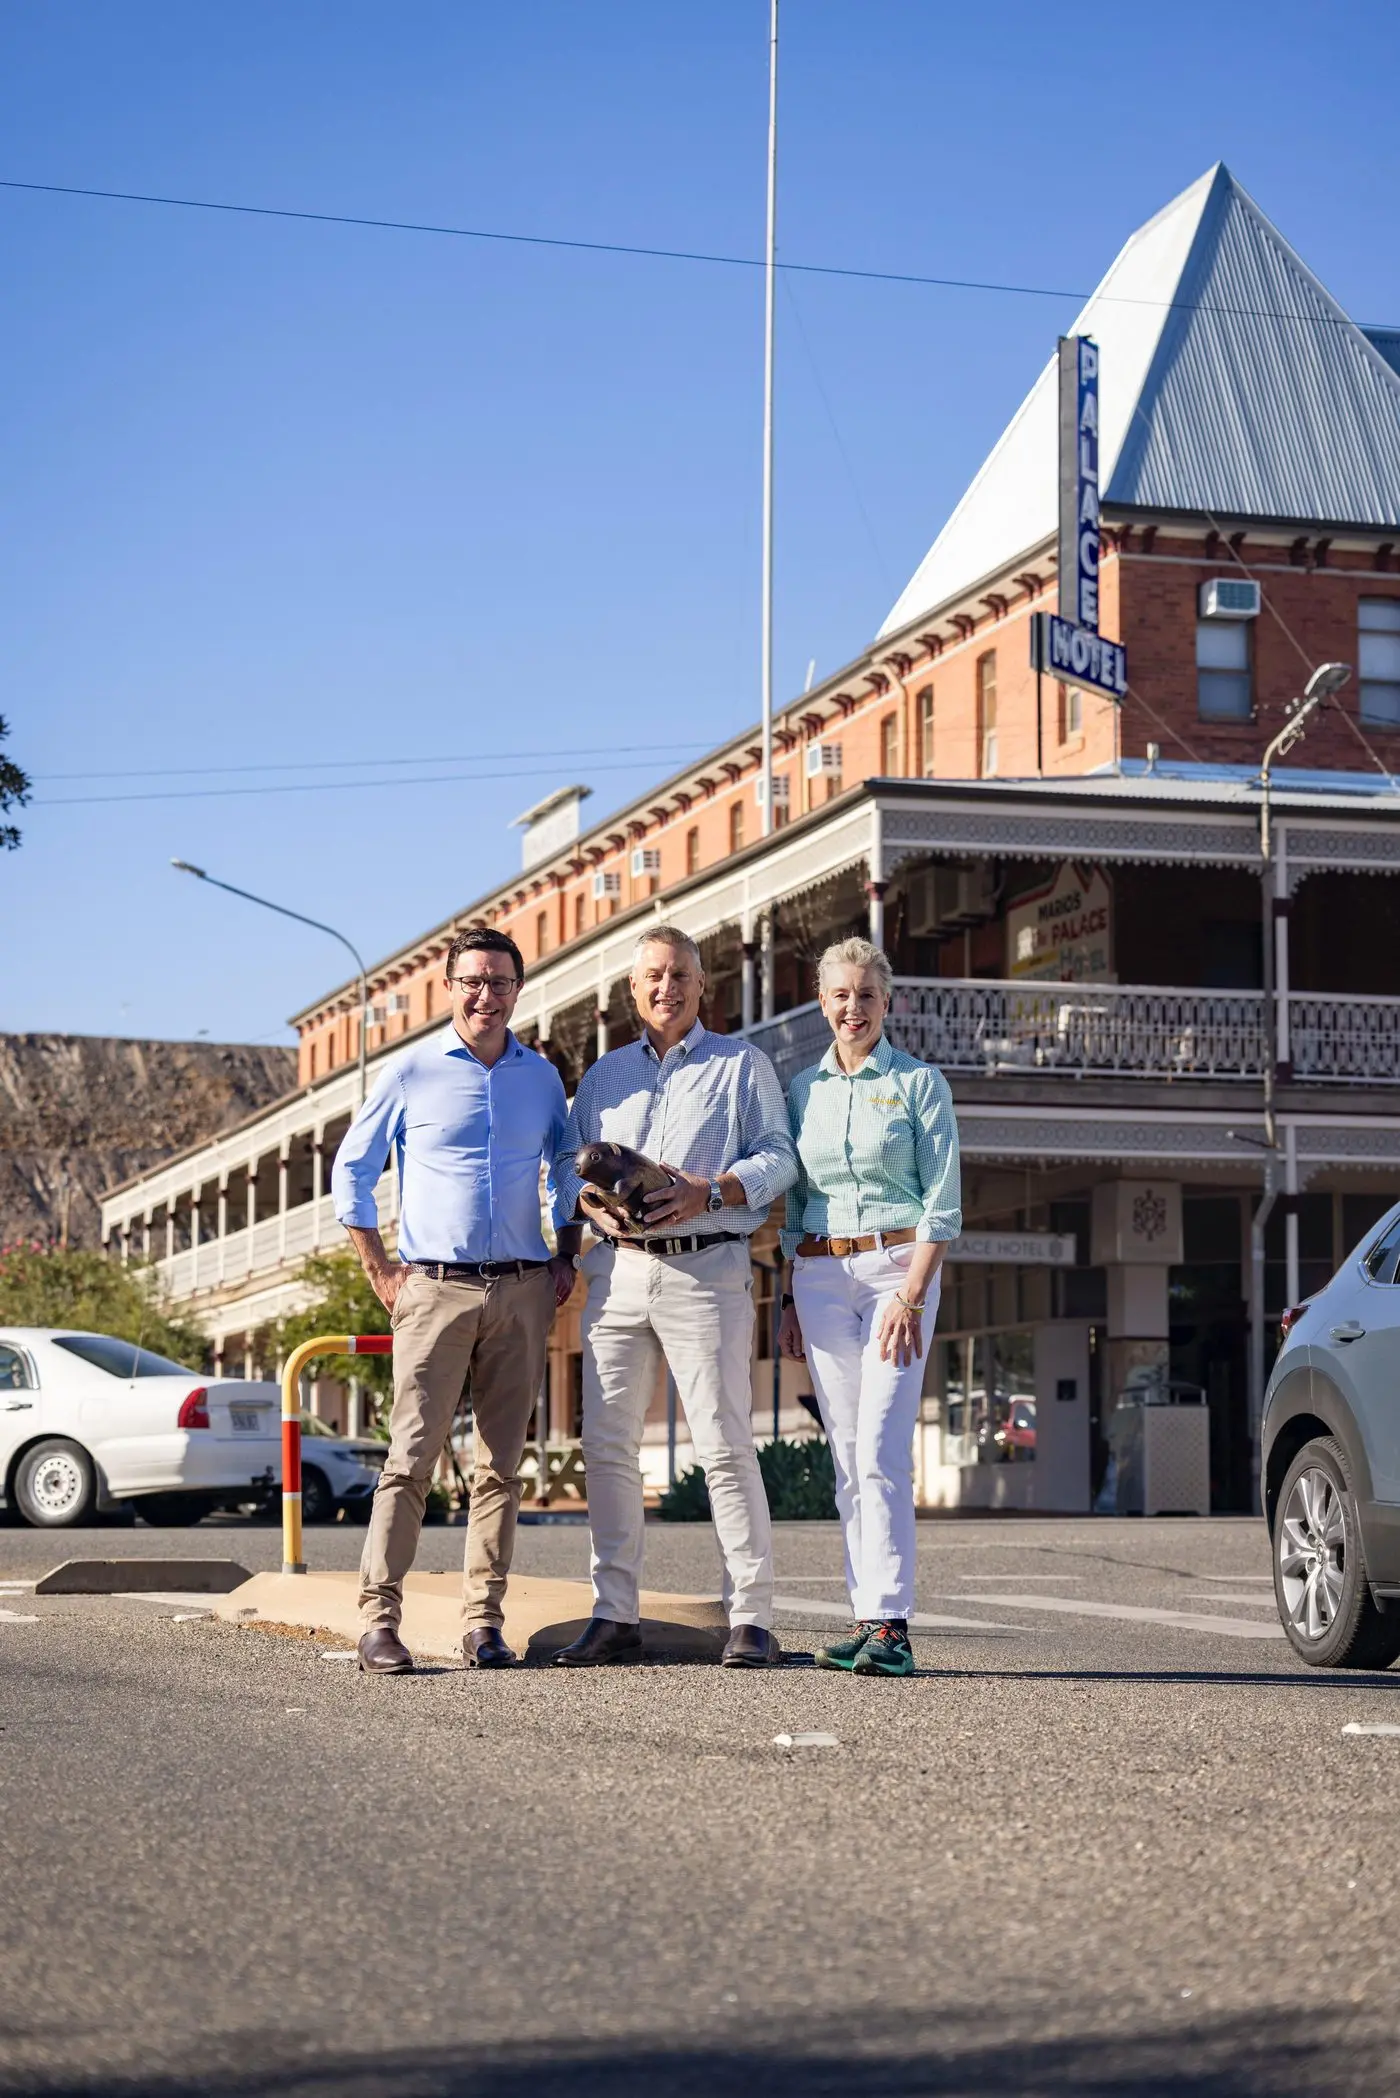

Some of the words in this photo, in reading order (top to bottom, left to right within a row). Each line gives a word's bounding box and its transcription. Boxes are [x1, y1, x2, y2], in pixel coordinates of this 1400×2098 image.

[1079, 342, 1098, 624] PALACE
[1052, 619, 1127, 692] HOTEL
[1051, 907, 1107, 947] PALACE
[997, 1240, 1044, 1257] HOTEL
